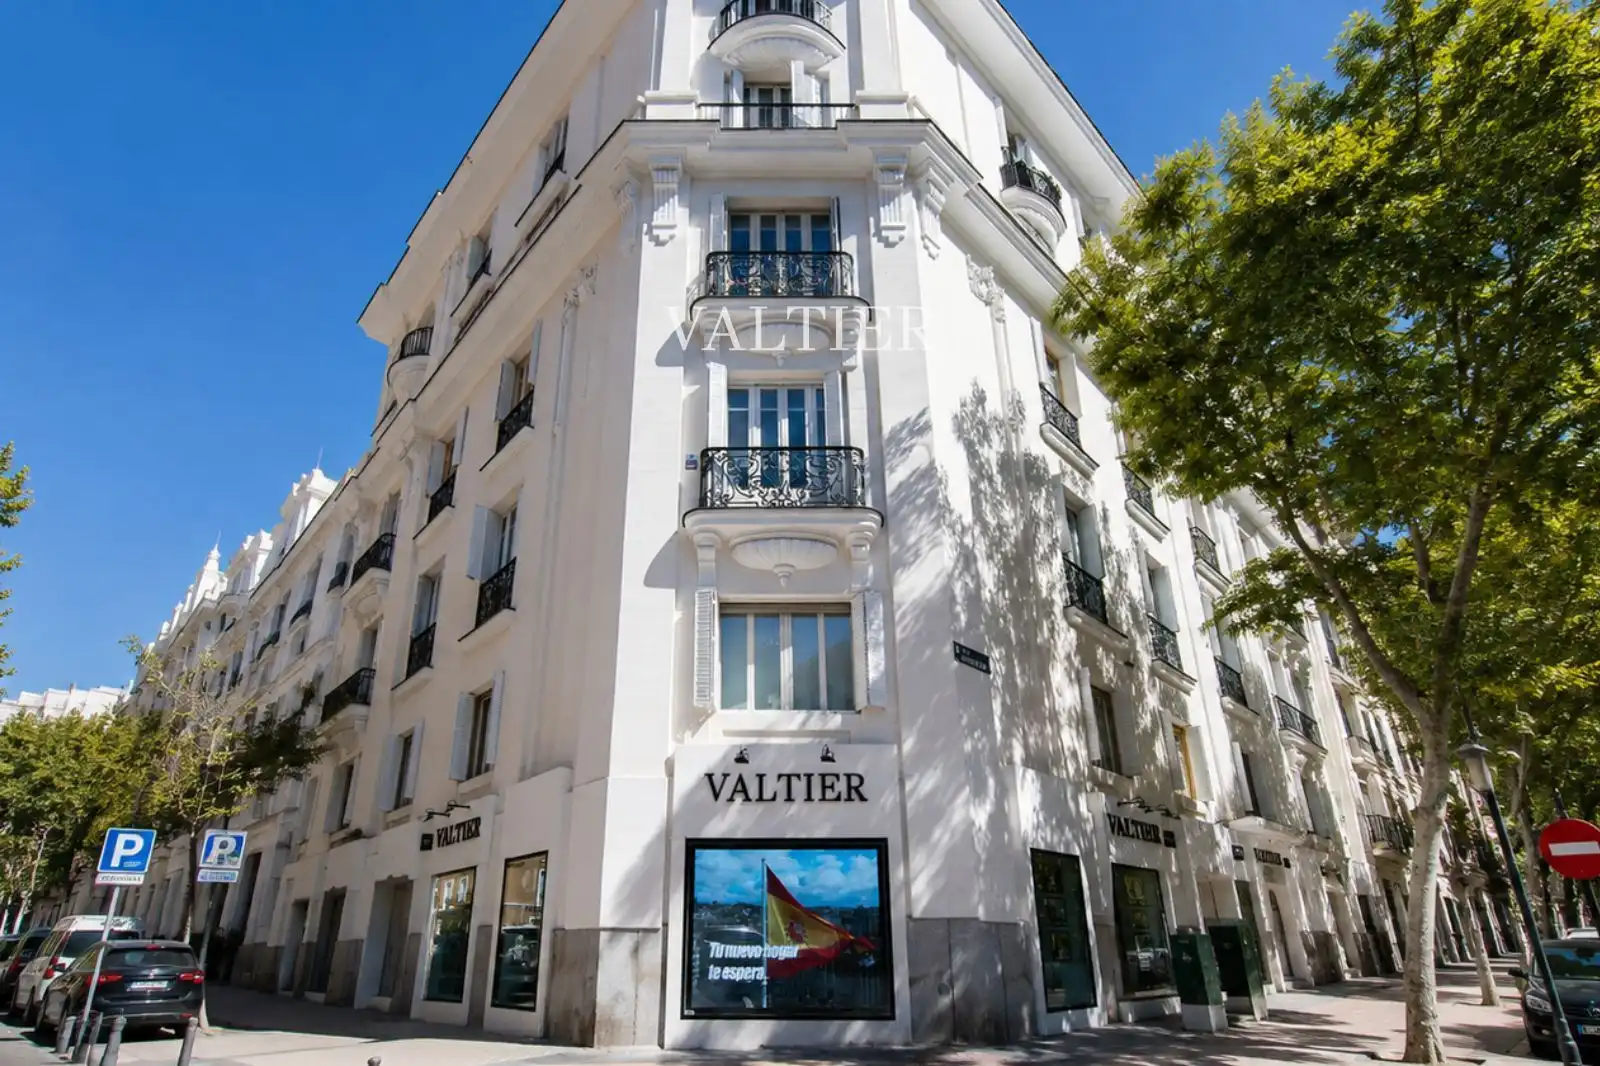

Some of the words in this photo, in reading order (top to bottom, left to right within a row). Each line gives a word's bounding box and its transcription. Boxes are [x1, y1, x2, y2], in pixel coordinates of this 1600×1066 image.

[704, 772, 868, 802] VALTIER
[436, 816, 481, 848] VALTIER
[1106, 812, 1162, 845] VALTIER
[110, 833, 145, 868] P
[709, 942, 724, 958] Tu
[724, 944, 763, 959] nuevo
[763, 943, 799, 960] hogar
[708, 964, 721, 980] te
